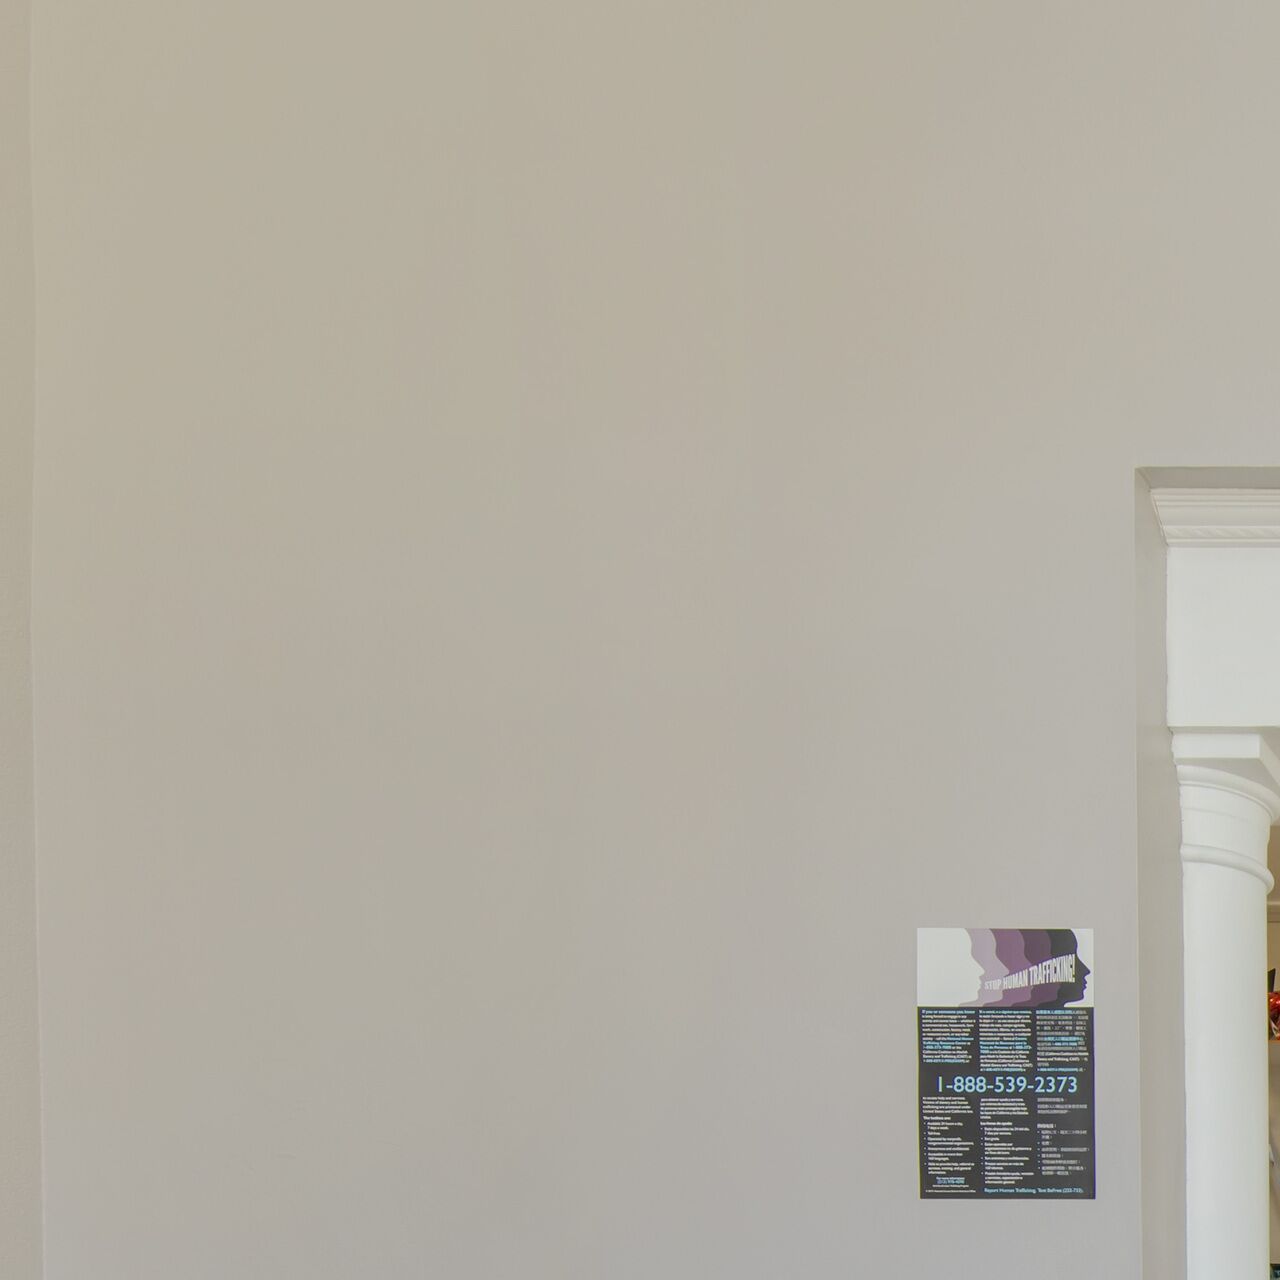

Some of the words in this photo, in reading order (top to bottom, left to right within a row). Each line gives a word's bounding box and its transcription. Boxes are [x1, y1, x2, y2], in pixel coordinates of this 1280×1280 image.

[984, 980, 1001, 990] STOP
[1003, 969, 1028, 989] HUMAN
[1029, 954, 1075, 985] TRAFFICKING!
[938, 1076, 1078, 1093] 1-888-539-2373
